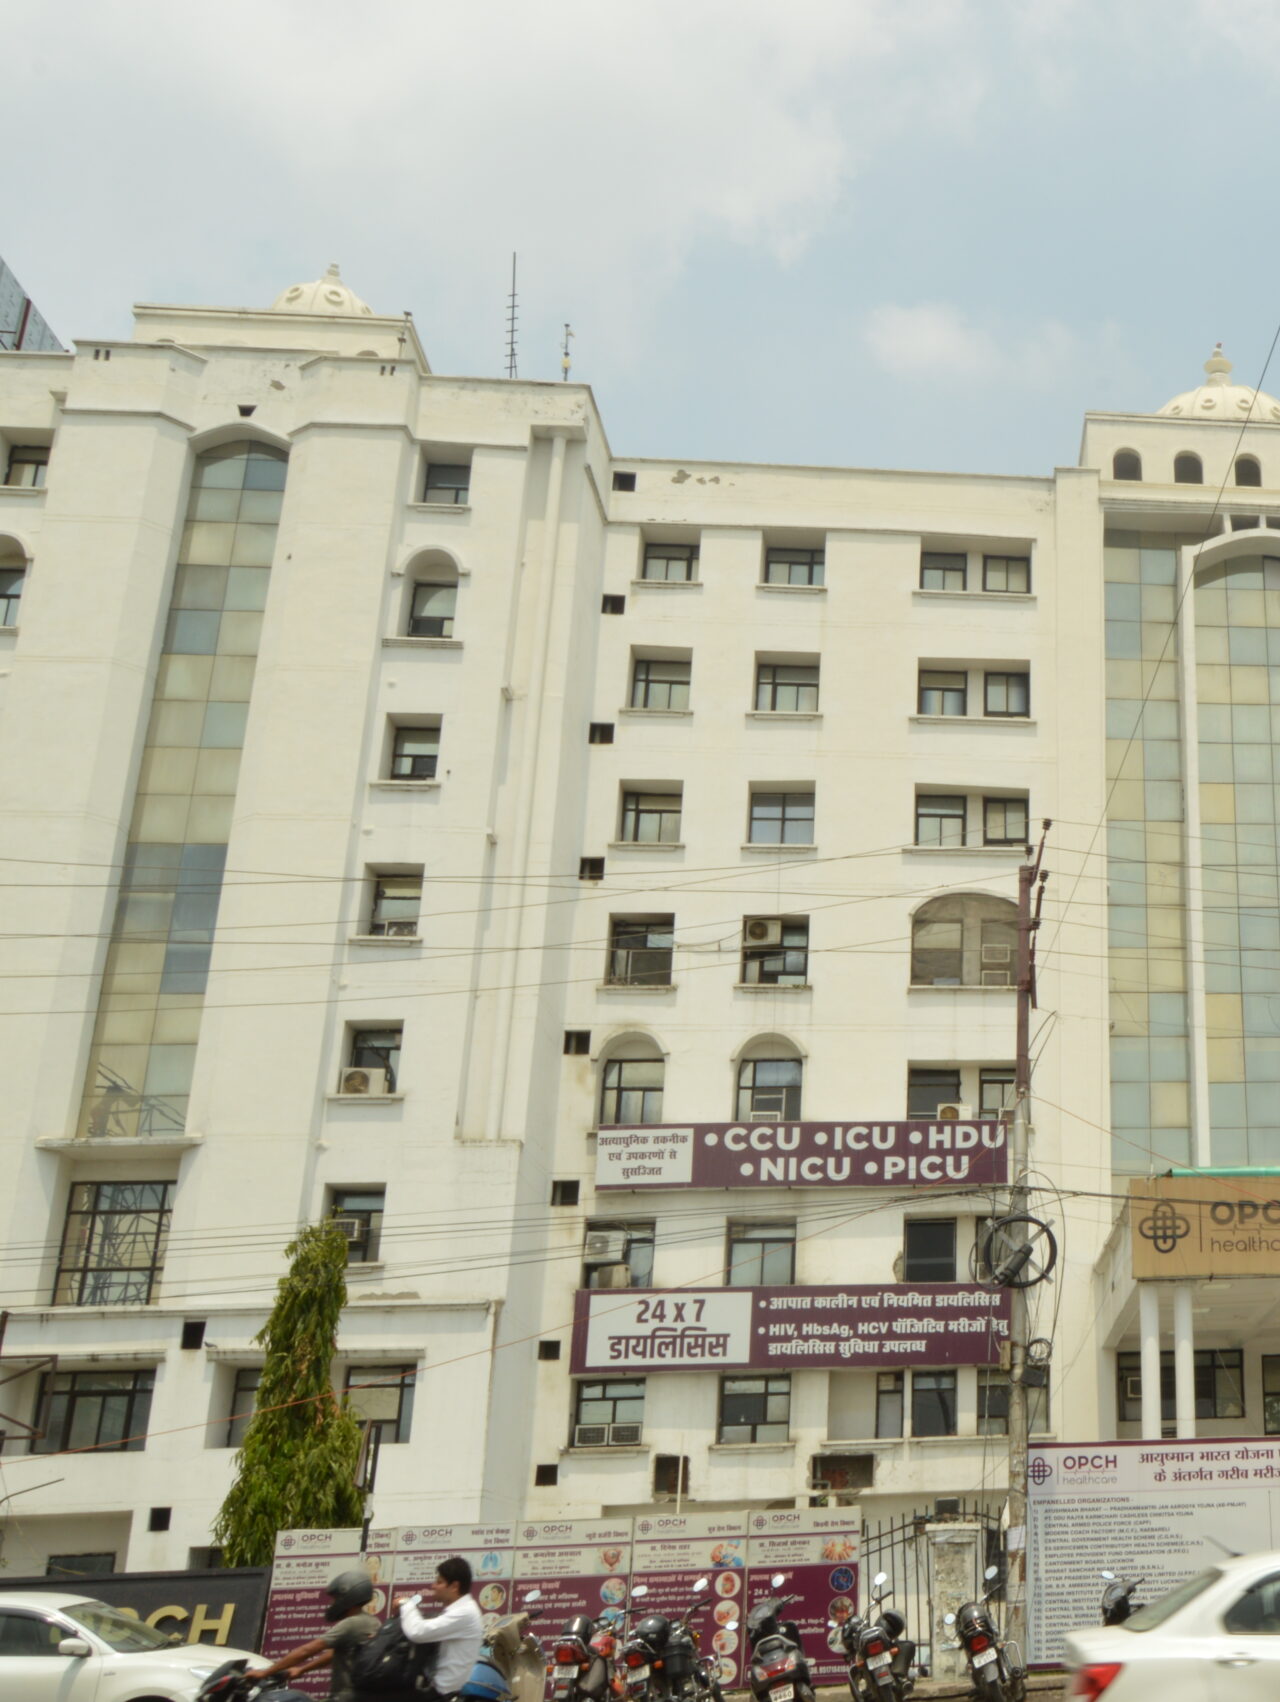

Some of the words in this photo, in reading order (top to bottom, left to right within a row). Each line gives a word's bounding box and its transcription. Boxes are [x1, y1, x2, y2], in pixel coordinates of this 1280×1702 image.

[652, 1132, 688, 1144] तकनीक
[724, 1127, 801, 1151] CCU
[834, 1126, 896, 1150] ICU
[928, 1125, 1005, 1149] HDU
[608, 1149, 624, 1161] एवं
[626, 1148, 667, 1160] उपकरणों
[669, 1149, 678, 1160] से
[760, 1156, 851, 1181] NICU
[884, 1155, 970, 1180] PICU
[770, 1297, 812, 1309] आपात
[814, 1293, 859, 1309] कालीन
[861, 1292, 881, 1308] एवं
[883, 1292, 933, 1308] नियमित
[936, 1291, 1001, 1307] डायलिसिस
[636, 1299, 667, 1324] 24
[693, 1299, 706, 1322] 7
[769, 1323, 798, 1338] HIV,
[802, 1323, 854, 1338] HbsAg,
[858, 1322, 889, 1334] HCV
[892, 1317, 946, 1333] पॉजिटिव
[948, 1317, 988, 1333] मरीजों
[608, 1326, 731, 1360] डायलिसिस
[768, 1339, 836, 1355] डायलिसिस
[838, 1338, 881, 1358] सुविधा
[882, 1340, 927, 1353] उपलब्ध
[1063, 1454, 1118, 1470] OPCH
[1139, 1451, 1195, 1466] आयुष्मान
[1199, 1451, 1230, 1462] भारत
[1234, 1446, 1274, 1461] योजना
[1063, 1476, 1118, 1485] healthcare
[1153, 1468, 1167, 1482] के
[1172, 1467, 1213, 1481] अंतर्गत
[1217, 1466, 1249, 1480] गरीब
[1033, 1498, 1076, 1506] EMPANELLED
[1077, 1497, 1130, 1505] ORGANIZATIONS
[657, 1518, 687, 1527] OPCH
[772, 1513, 801, 1523] OPCH
[423, 1529, 453, 1538] OPCH
[543, 1525, 573, 1534] OPCH
[302, 1533, 333, 1543] OPCH
